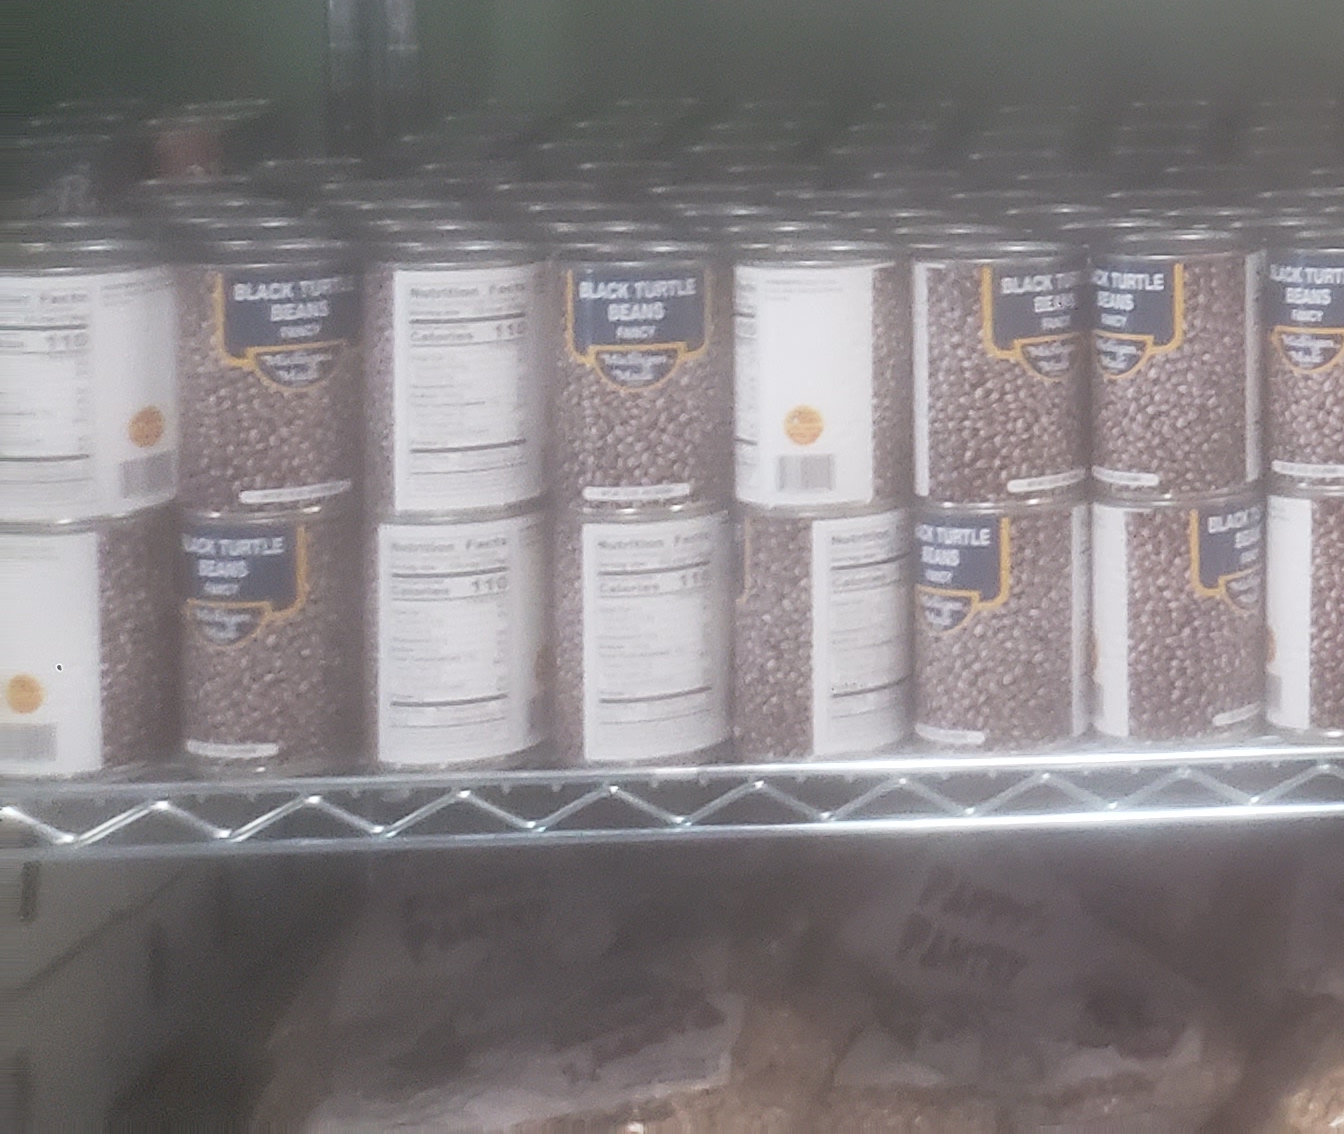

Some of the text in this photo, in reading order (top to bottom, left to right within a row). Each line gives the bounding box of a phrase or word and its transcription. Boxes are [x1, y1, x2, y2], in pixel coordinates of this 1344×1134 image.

[1111, 272, 1165, 291] TURTLE
[1285, 287, 1332, 305] BEANS
[937, 526, 990, 546] TURTLE
